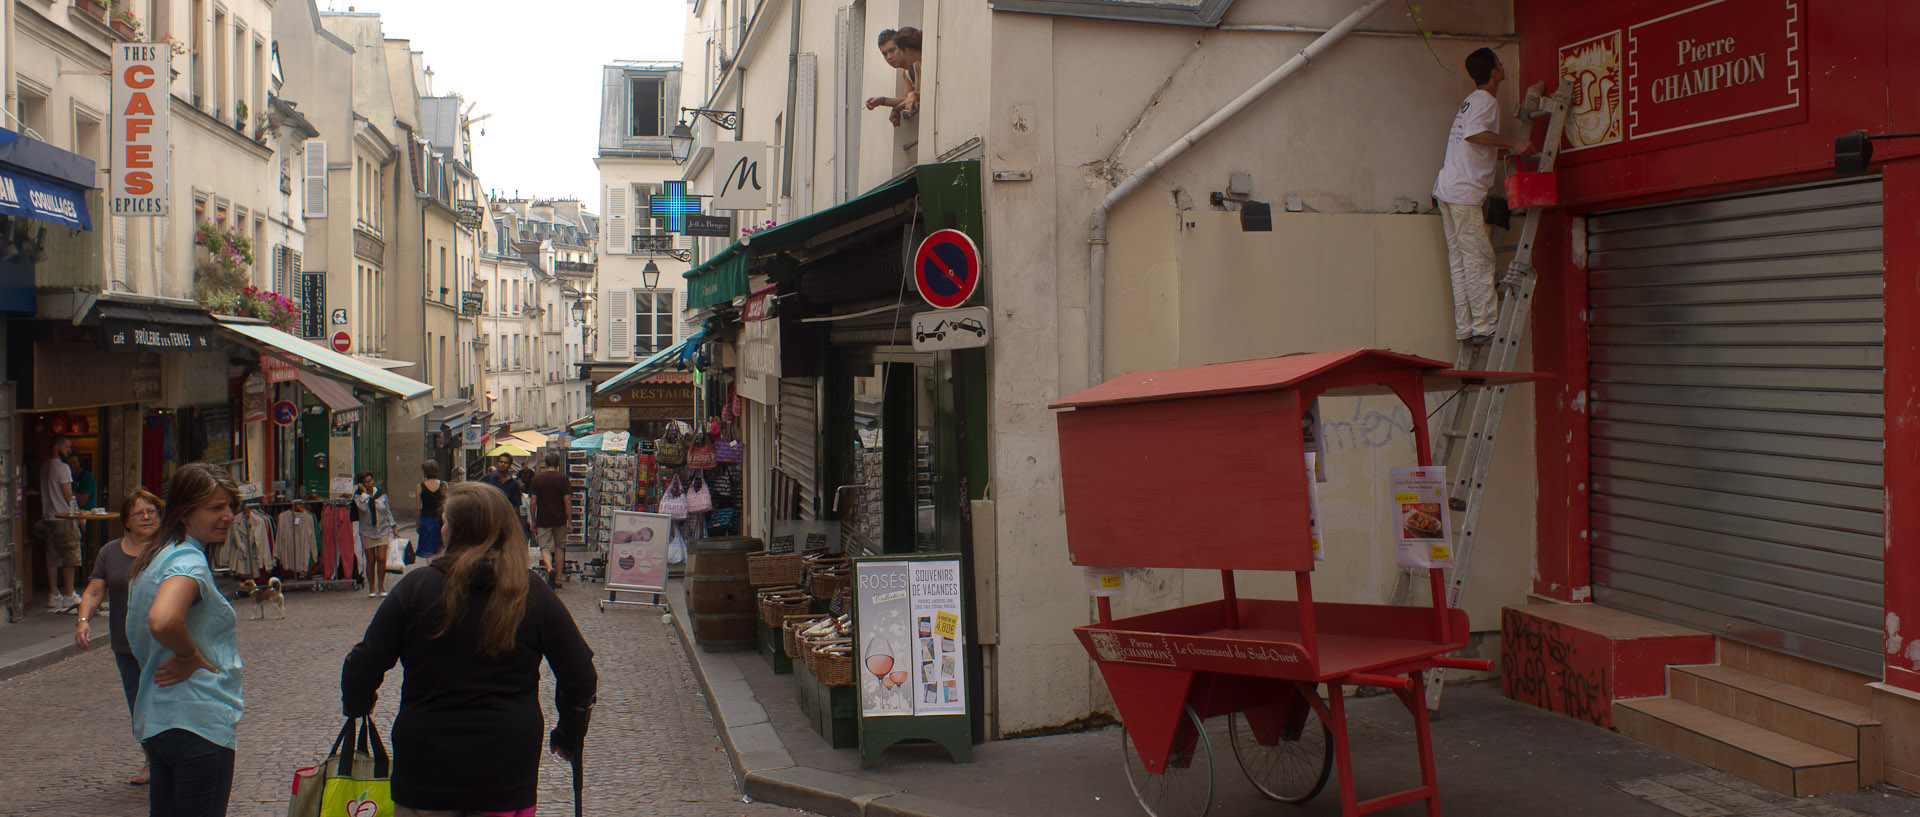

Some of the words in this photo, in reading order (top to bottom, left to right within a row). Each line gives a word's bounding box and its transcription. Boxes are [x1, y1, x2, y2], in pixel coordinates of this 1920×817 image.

[124, 46, 156, 61] THES
[1676, 36, 1736, 67] Pierre
[1651, 53, 1766, 104] CHAMPION
[124, 65, 155, 195] CAFES
[29, 189, 78, 219] COQUILLAGES
[115, 198, 162, 212] EPICES
[706, 220, 728, 230] Bruges
[860, 571, 907, 589] ROSÉS
[915, 569, 954, 582] SOUVENIRS
[912, 584, 920, 596] DE
[923, 583, 958, 596] VACANCES
[1129, 637, 1153, 649] Pierre
[1124, 647, 1169, 661] CHAMPION
[1175, 643, 1187, 655] Le
[1187, 643, 1234, 658] Gourmand
[1235, 645, 1247, 659] du
[1249, 646, 1298, 663] Sud-Ouest
